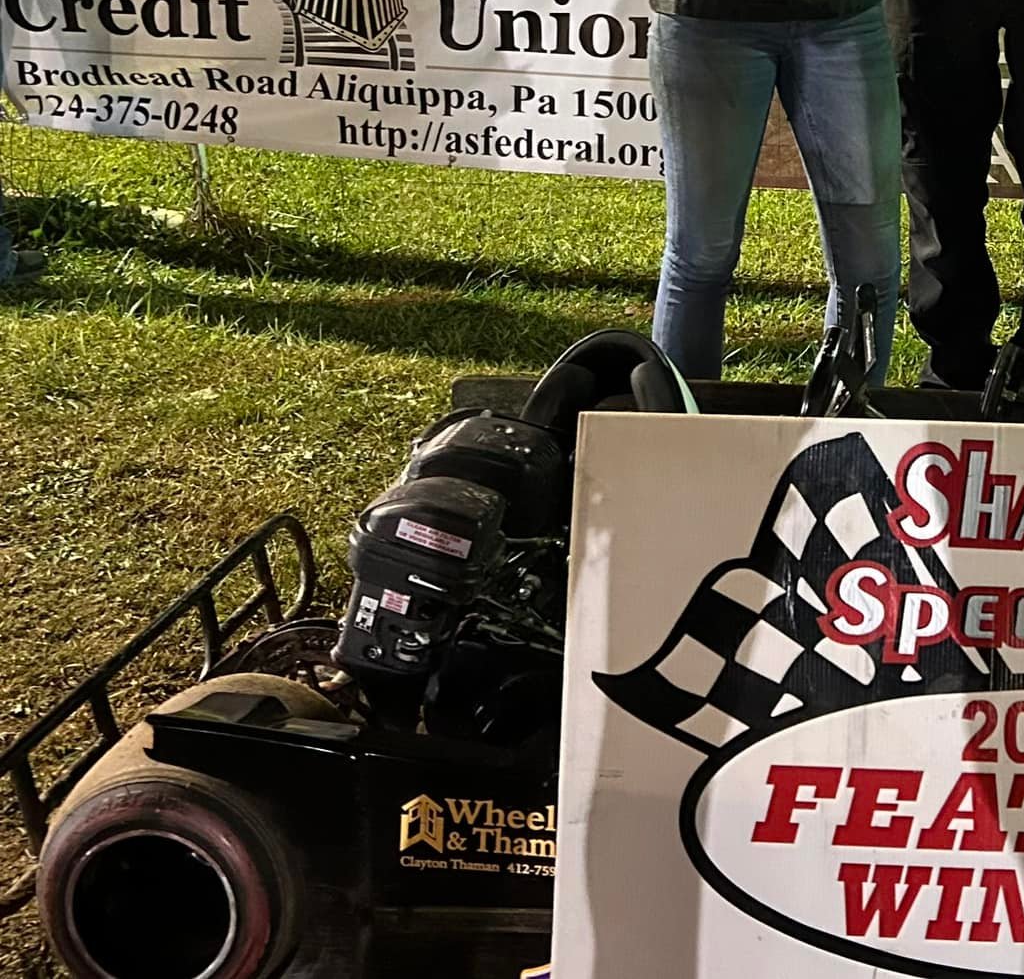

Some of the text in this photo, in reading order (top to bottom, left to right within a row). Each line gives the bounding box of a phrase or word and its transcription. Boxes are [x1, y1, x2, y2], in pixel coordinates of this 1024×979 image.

[16, 60, 194, 89] Brodhead
[203, 67, 298, 97] Road
[306, 72, 498, 117] Aliquippa,
[511, 85, 559, 115] Pa
[25, 94, 238, 136] 724-375-0248
[445, 797, 556, 832] Wheel
[446, 828, 557, 859] & Tham
[400, 856, 448, 870] Clayton
